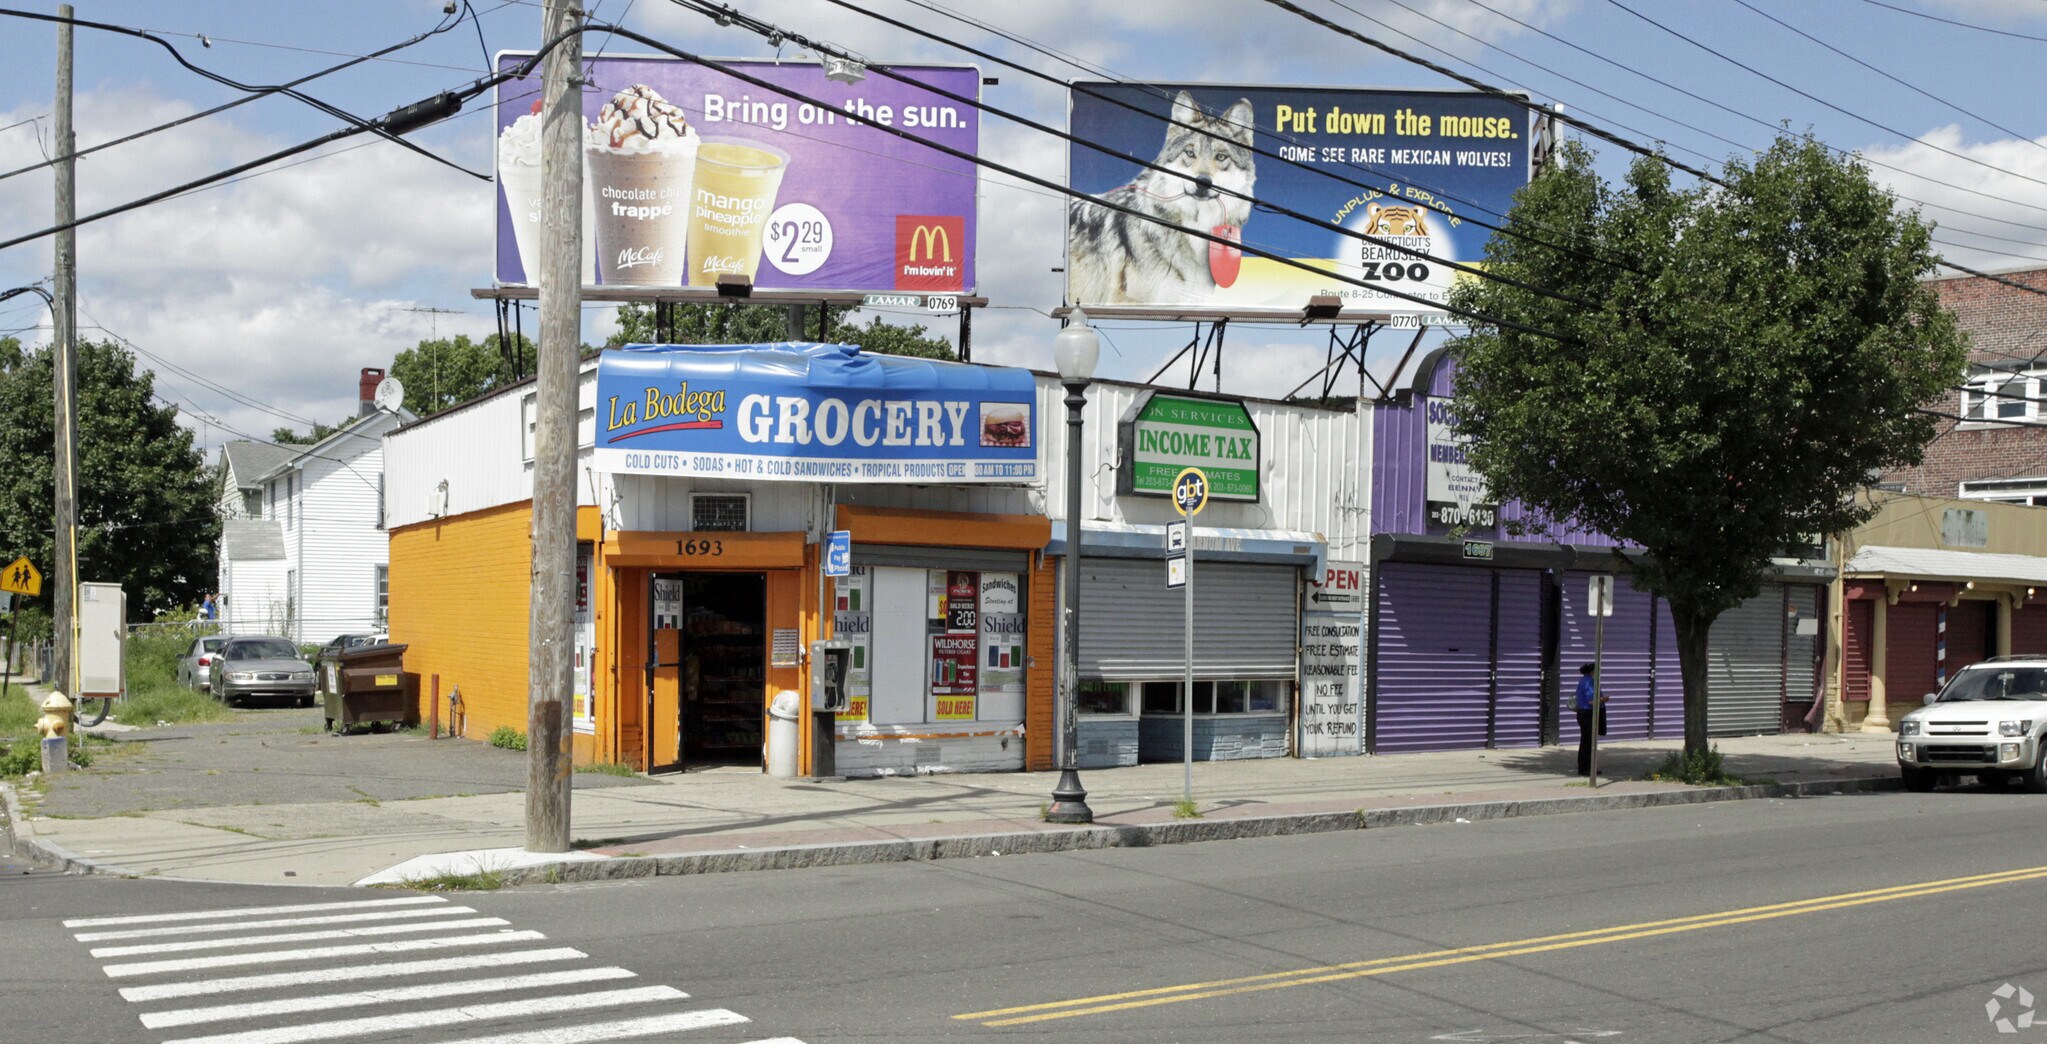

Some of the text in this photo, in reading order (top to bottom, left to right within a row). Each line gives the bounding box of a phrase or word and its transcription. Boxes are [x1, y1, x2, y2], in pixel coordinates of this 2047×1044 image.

[704, 94, 966, 131] Bring on the sun.
[1277, 104, 1518, 139] Put down the mouse.
[1279, 146, 1511, 167] COME SEE RARE MEXICAN WOLVES!
[602, 185, 683, 202] chocolate chip
[697, 188, 765, 216] mango
[1331, 183, 1462, 228] UNPLUG & EXPLORE
[612, 201, 673, 221] frappé
[696, 205, 762, 227] pineapple
[704, 223, 750, 237] smoothie
[618, 246, 664, 268] McCafé
[801, 245, 823, 253] small
[703, 256, 745, 273] McCafé
[946, 266, 954, 276] it
[1362, 262, 1430, 282] ZOO
[868, 296, 916, 306] LAMAR
[1321, 289, 1350, 299] Route
[1352, 289, 1374, 299] 8-25
[1429, 291, 1439, 300] to
[929, 297, 955, 309] 0769
[1392, 315, 1418, 328] 0770
[1426, 316, 1464, 325] LAM
[607, 381, 726, 432] La Bodega
[736, 393, 968, 448] GROCERY
[1171, 409, 1244, 425] SERVICES
[1139, 429, 1252, 460] INCOME TAX
[625, 454, 650, 469] COLD
[654, 455, 679, 470] CUTS
[693, 456, 724, 472] SODAS
[735, 459, 754, 473] HOT
[756, 461, 764, 474] &
[767, 460, 791, 475] COLD
[794, 462, 852, 477] SANDWICHES
[862, 463, 901, 477] TROPICAL
[904, 463, 945, 477] PRODUCTS
[995, 464, 1003, 476] TO
[1023, 465, 1034, 476] PM
[1149, 466, 1178, 477] FREE
[1452, 475, 1478, 483] CONTACT
[1177, 479, 1203, 504] gbt
[1448, 484, 1481, 493] BENNY
[676, 539, 723, 556] 1693
[654, 582, 680, 601] Shield
[982, 578, 1016, 594] Sandwiches
[984, 596, 1006, 606] Starting
[834, 616, 870, 633] hield
[984, 615, 1025, 634] Shield
[1304, 626, 1359, 637] FREE CONSULTATION
[934, 639, 976, 650] WILDHORSE
[1305, 644, 1359, 657] FREE ESTIMATE
[1304, 664, 1358, 676] REASONABLE FEE
[1317, 684, 1343, 696] NO FEE
[937, 701, 973, 715] SOLD HERE!
[1305, 703, 1358, 715] UNTIL YOU GET
[1304, 722, 1357, 735] YOUR REFUND
